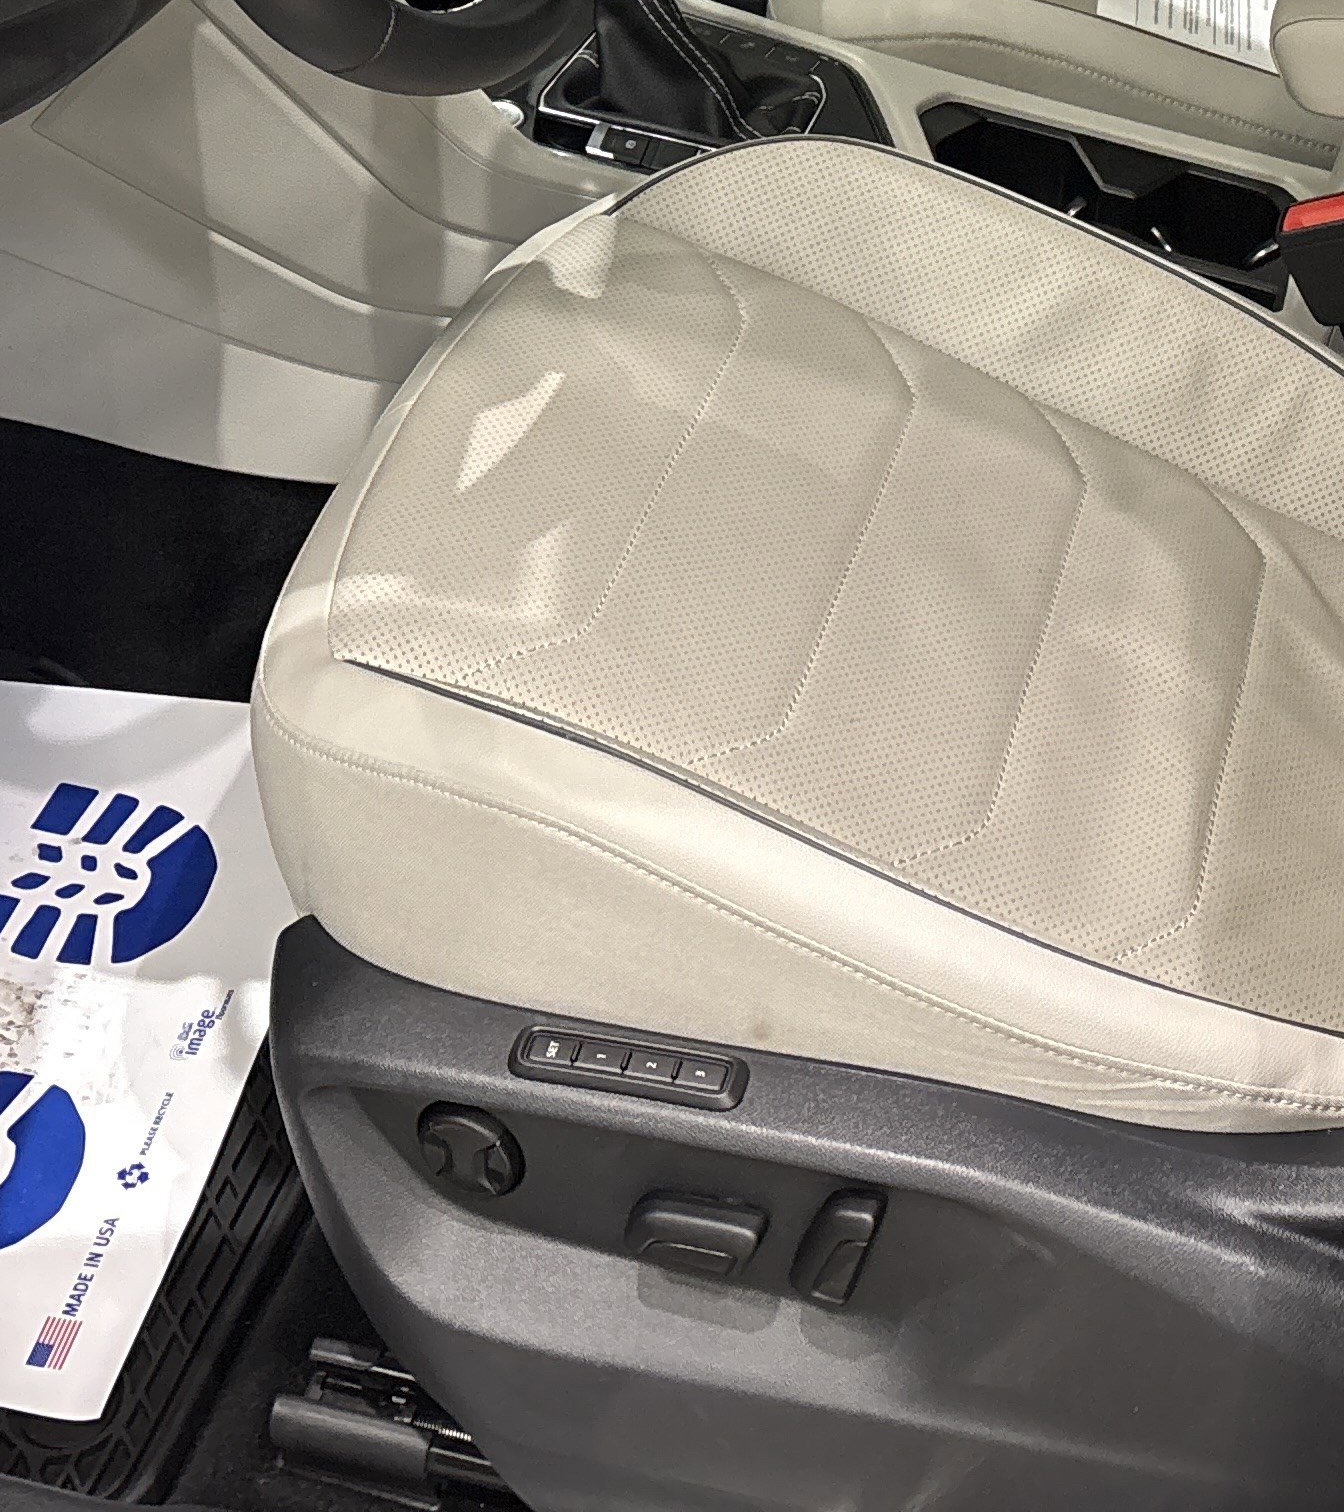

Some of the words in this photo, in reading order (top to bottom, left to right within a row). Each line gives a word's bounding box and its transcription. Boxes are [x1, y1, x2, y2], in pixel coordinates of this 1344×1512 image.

[184, 1009, 215, 1056] image
[545, 1040, 560, 1059] SET
[596, 1052, 607, 1060] 1
[645, 1060, 658, 1070] 2
[694, 1069, 706, 1079] 3
[139, 1126, 159, 1156] PLEASE
[152, 1091, 175, 1125] RECYCLE
[93, 1217, 120, 1247] USA
[83, 1251, 104, 1269] IN
[62, 1272, 95, 1317] MADE
